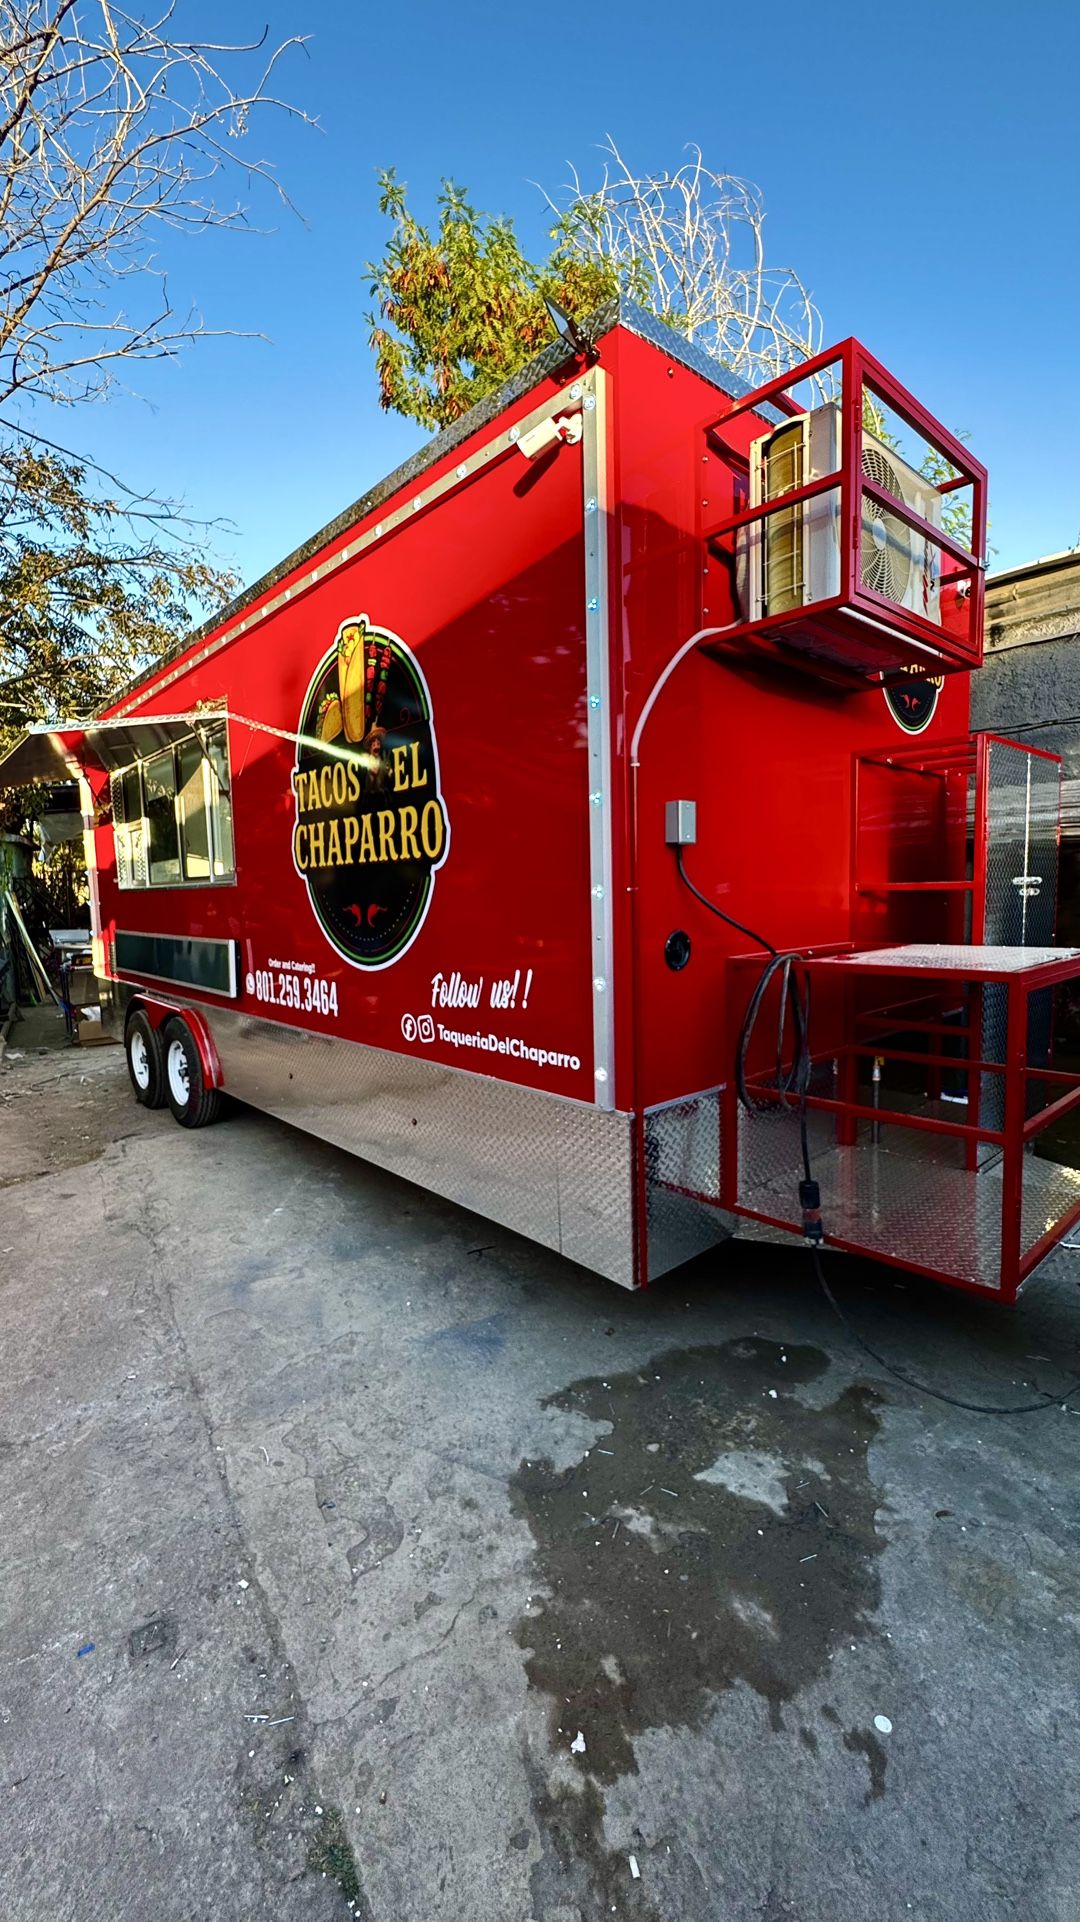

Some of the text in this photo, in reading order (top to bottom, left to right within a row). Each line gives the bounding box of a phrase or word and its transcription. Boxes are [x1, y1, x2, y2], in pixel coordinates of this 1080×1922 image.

[294, 741, 428, 813] TACOS EL
[295, 800, 443, 870] CHAPARRO
[268, 958, 282, 968] Order
[282, 960, 291, 970] and
[255, 970, 338, 1017] 801.259.3464
[431, 972, 483, 1008] Follow
[437, 1024, 581, 1070] TaqueriaDelChaparro
